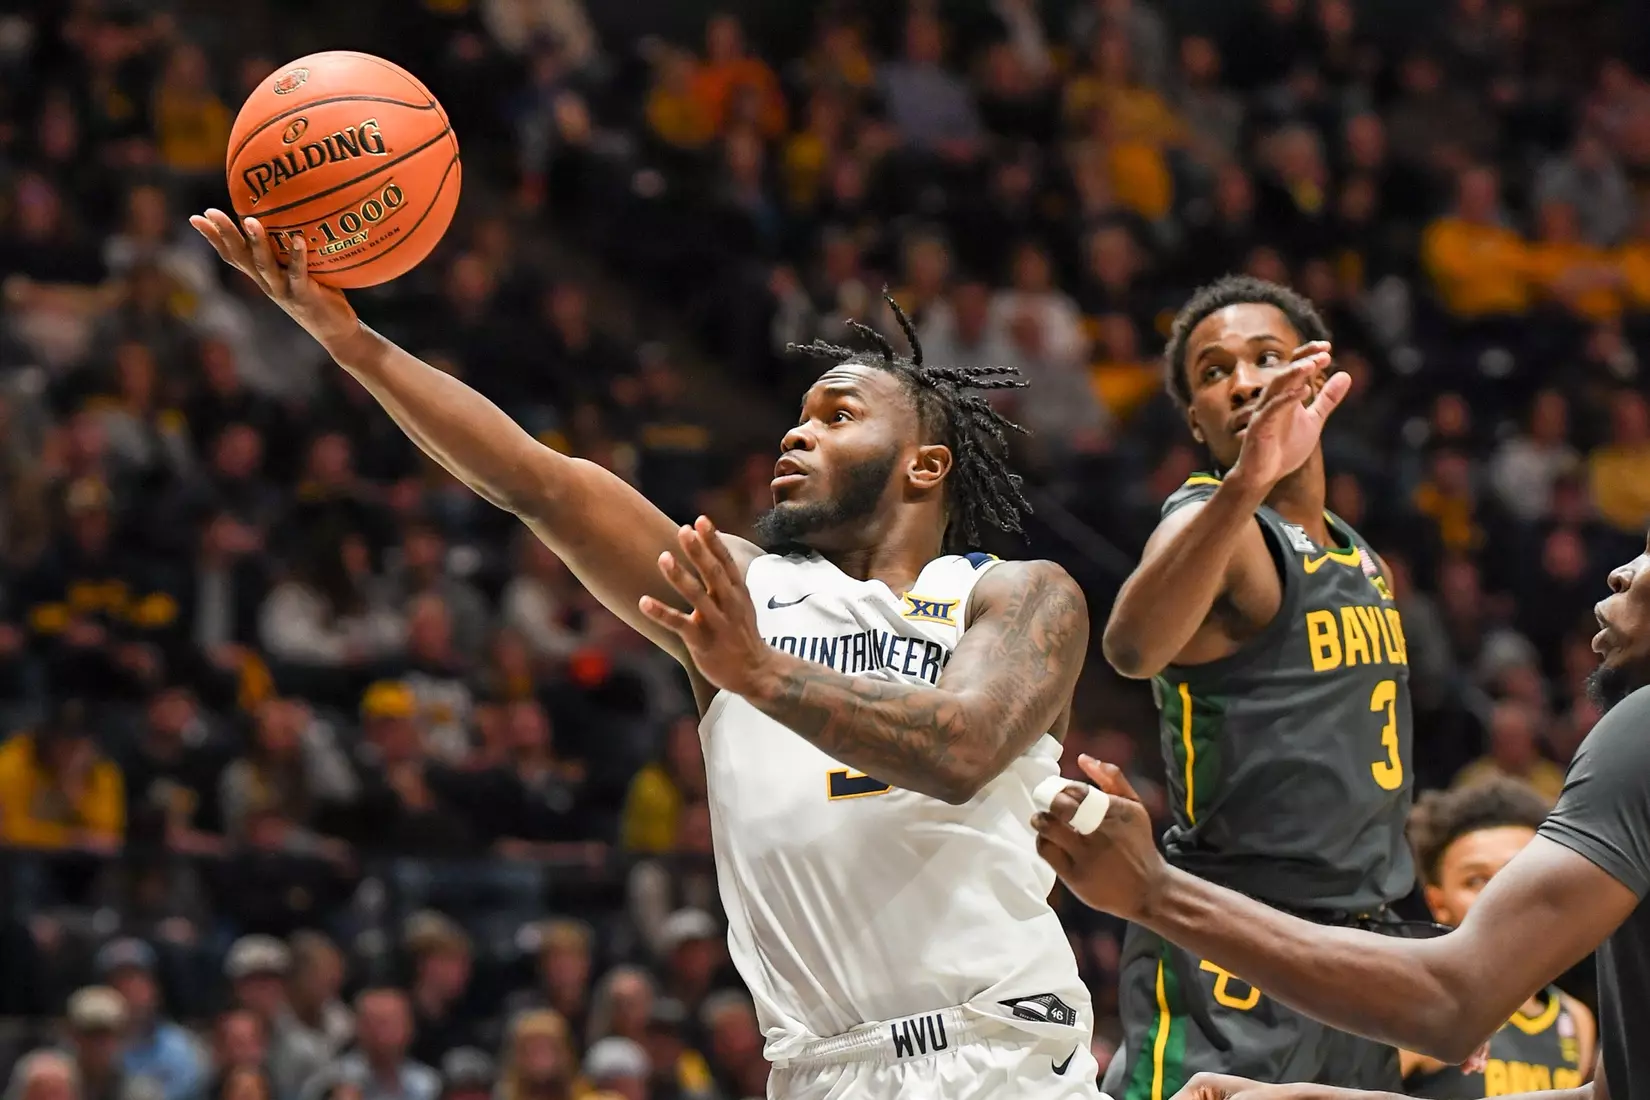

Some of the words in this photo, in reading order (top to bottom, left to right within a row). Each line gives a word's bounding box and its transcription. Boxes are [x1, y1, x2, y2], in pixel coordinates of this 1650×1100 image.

[242, 118, 388, 207] SPALDING
[318, 228, 369, 257] LEGACY
[369, 227, 401, 248] DESIGN
[763, 628, 952, 685] OUNTAINEER
[1370, 680, 1403, 790] 3
[891, 1013, 948, 1058] WVU
[1050, 1007, 1065, 1021] 46
